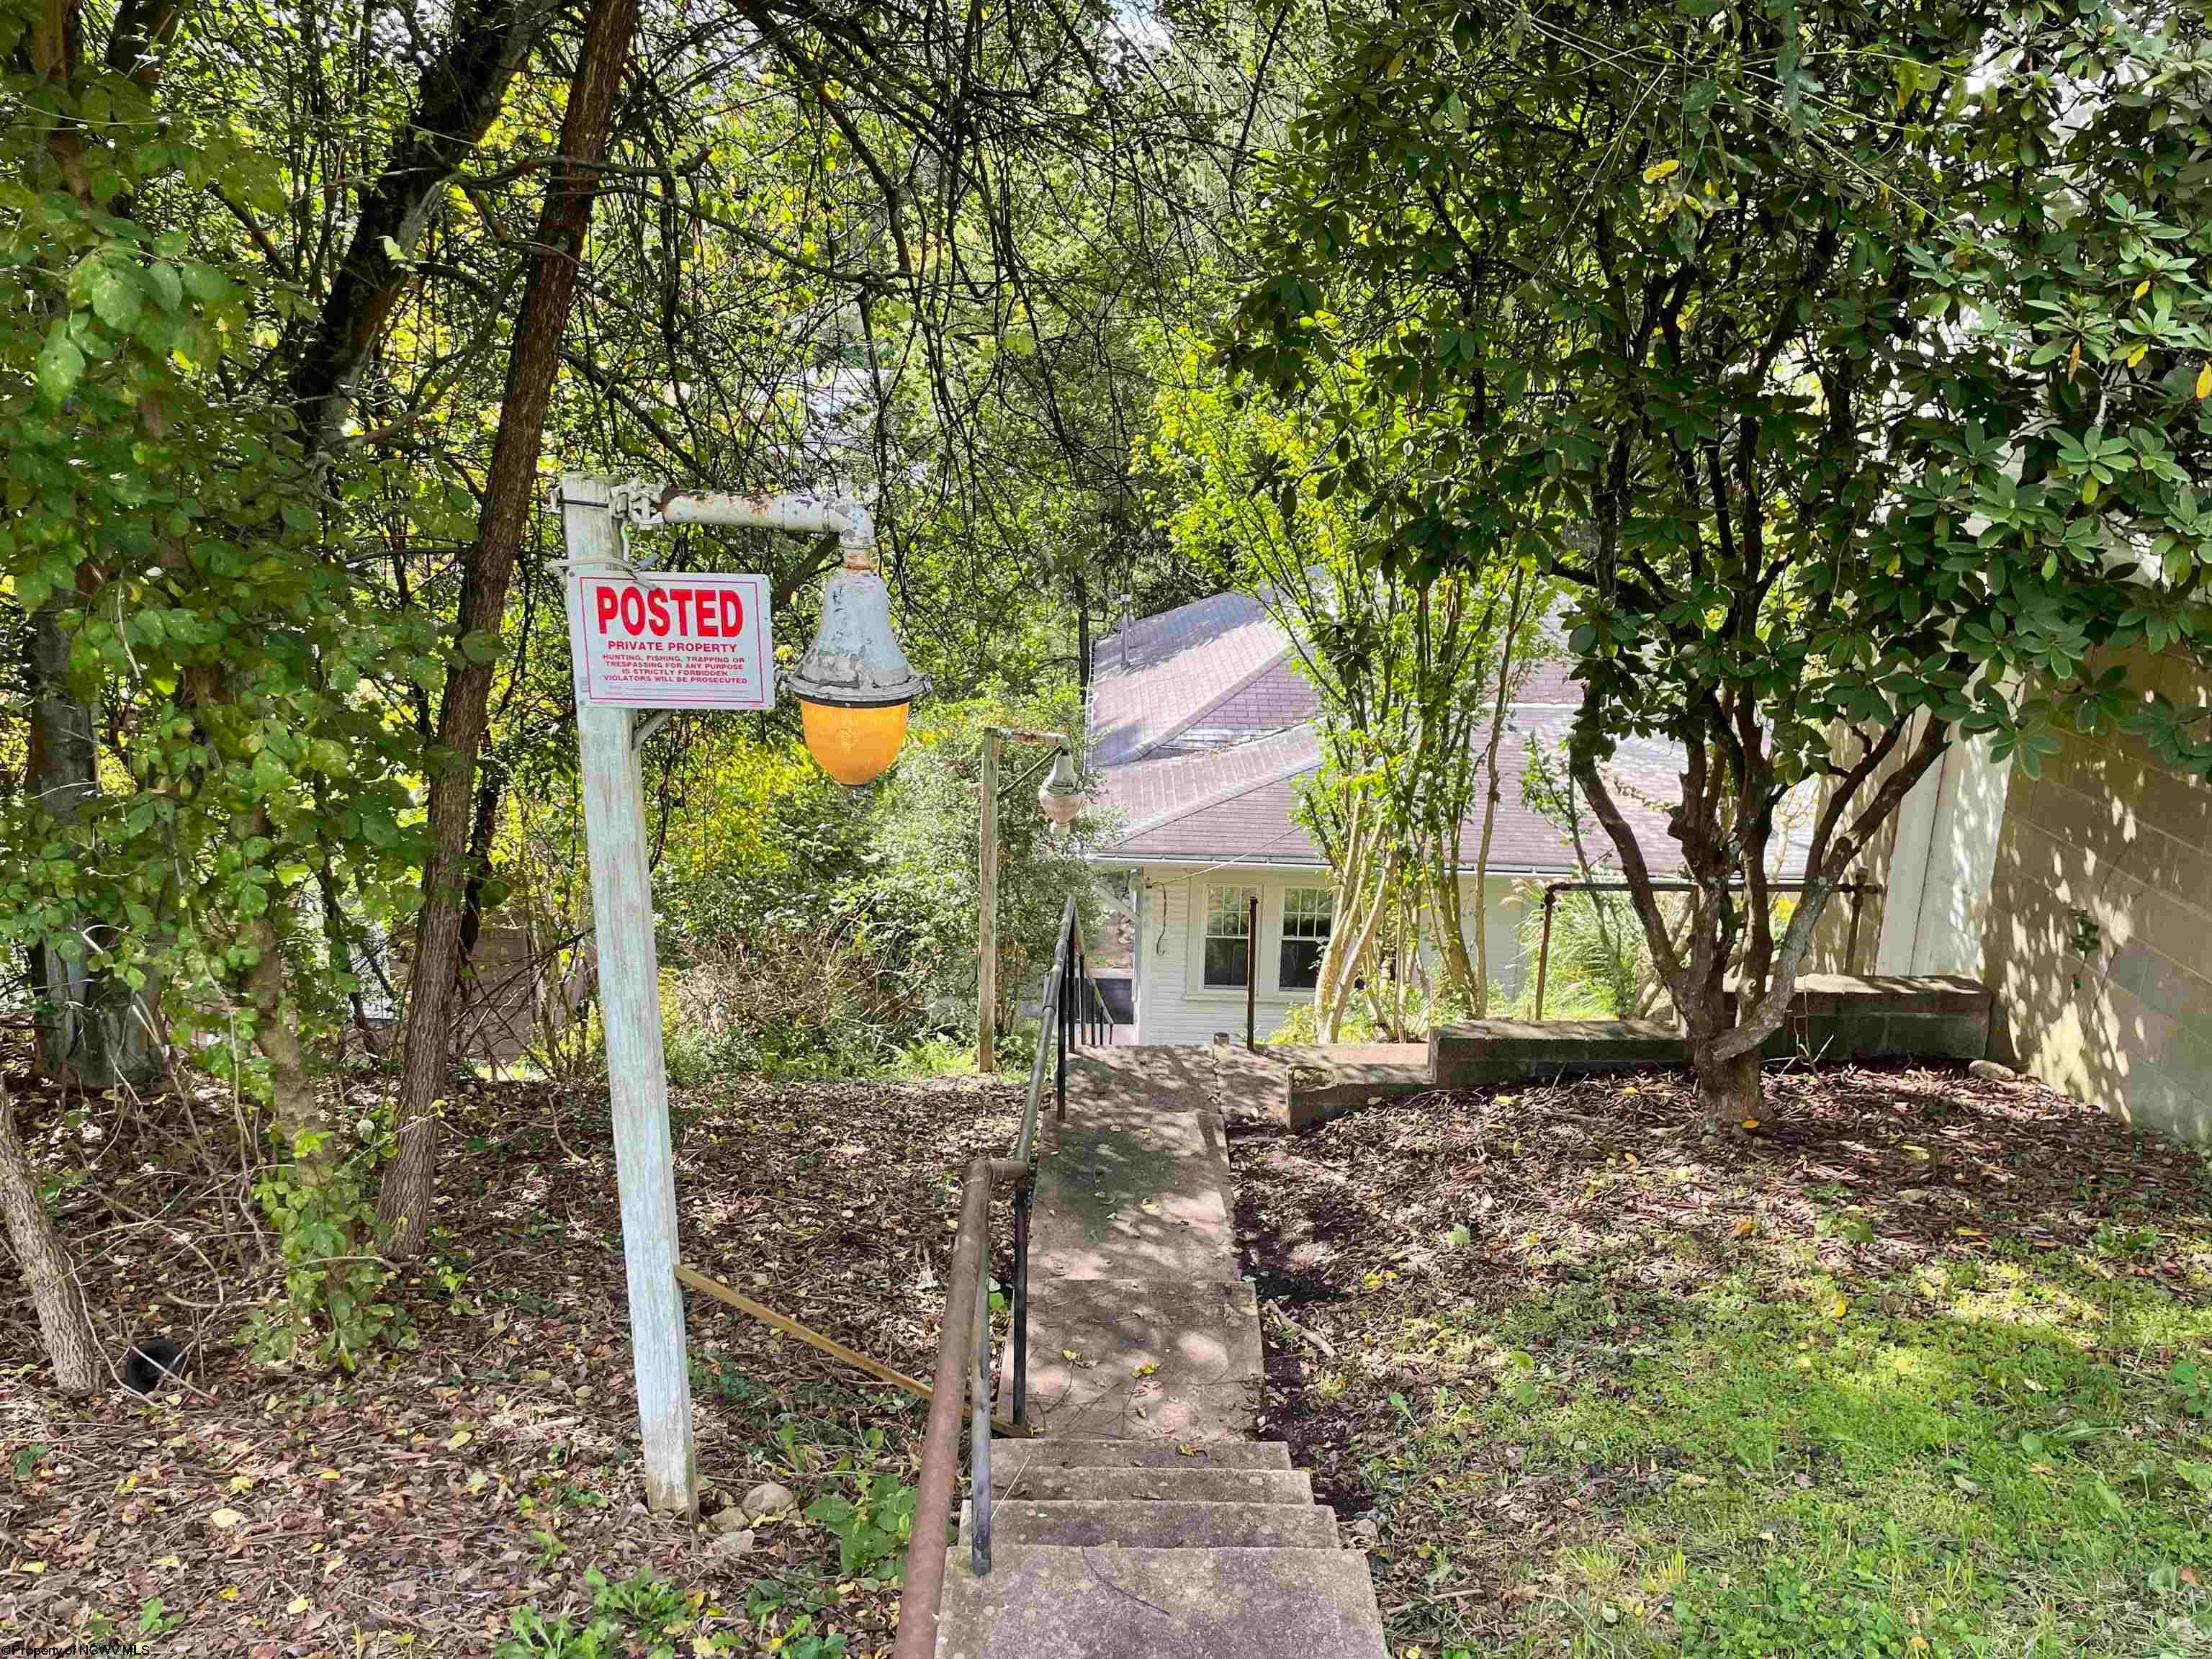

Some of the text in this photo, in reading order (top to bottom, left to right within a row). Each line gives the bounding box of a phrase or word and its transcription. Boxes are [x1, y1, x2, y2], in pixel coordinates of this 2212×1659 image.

[596, 586, 743, 637] POSTED
[608, 640, 737, 652] PRIVATE PROPERTY
